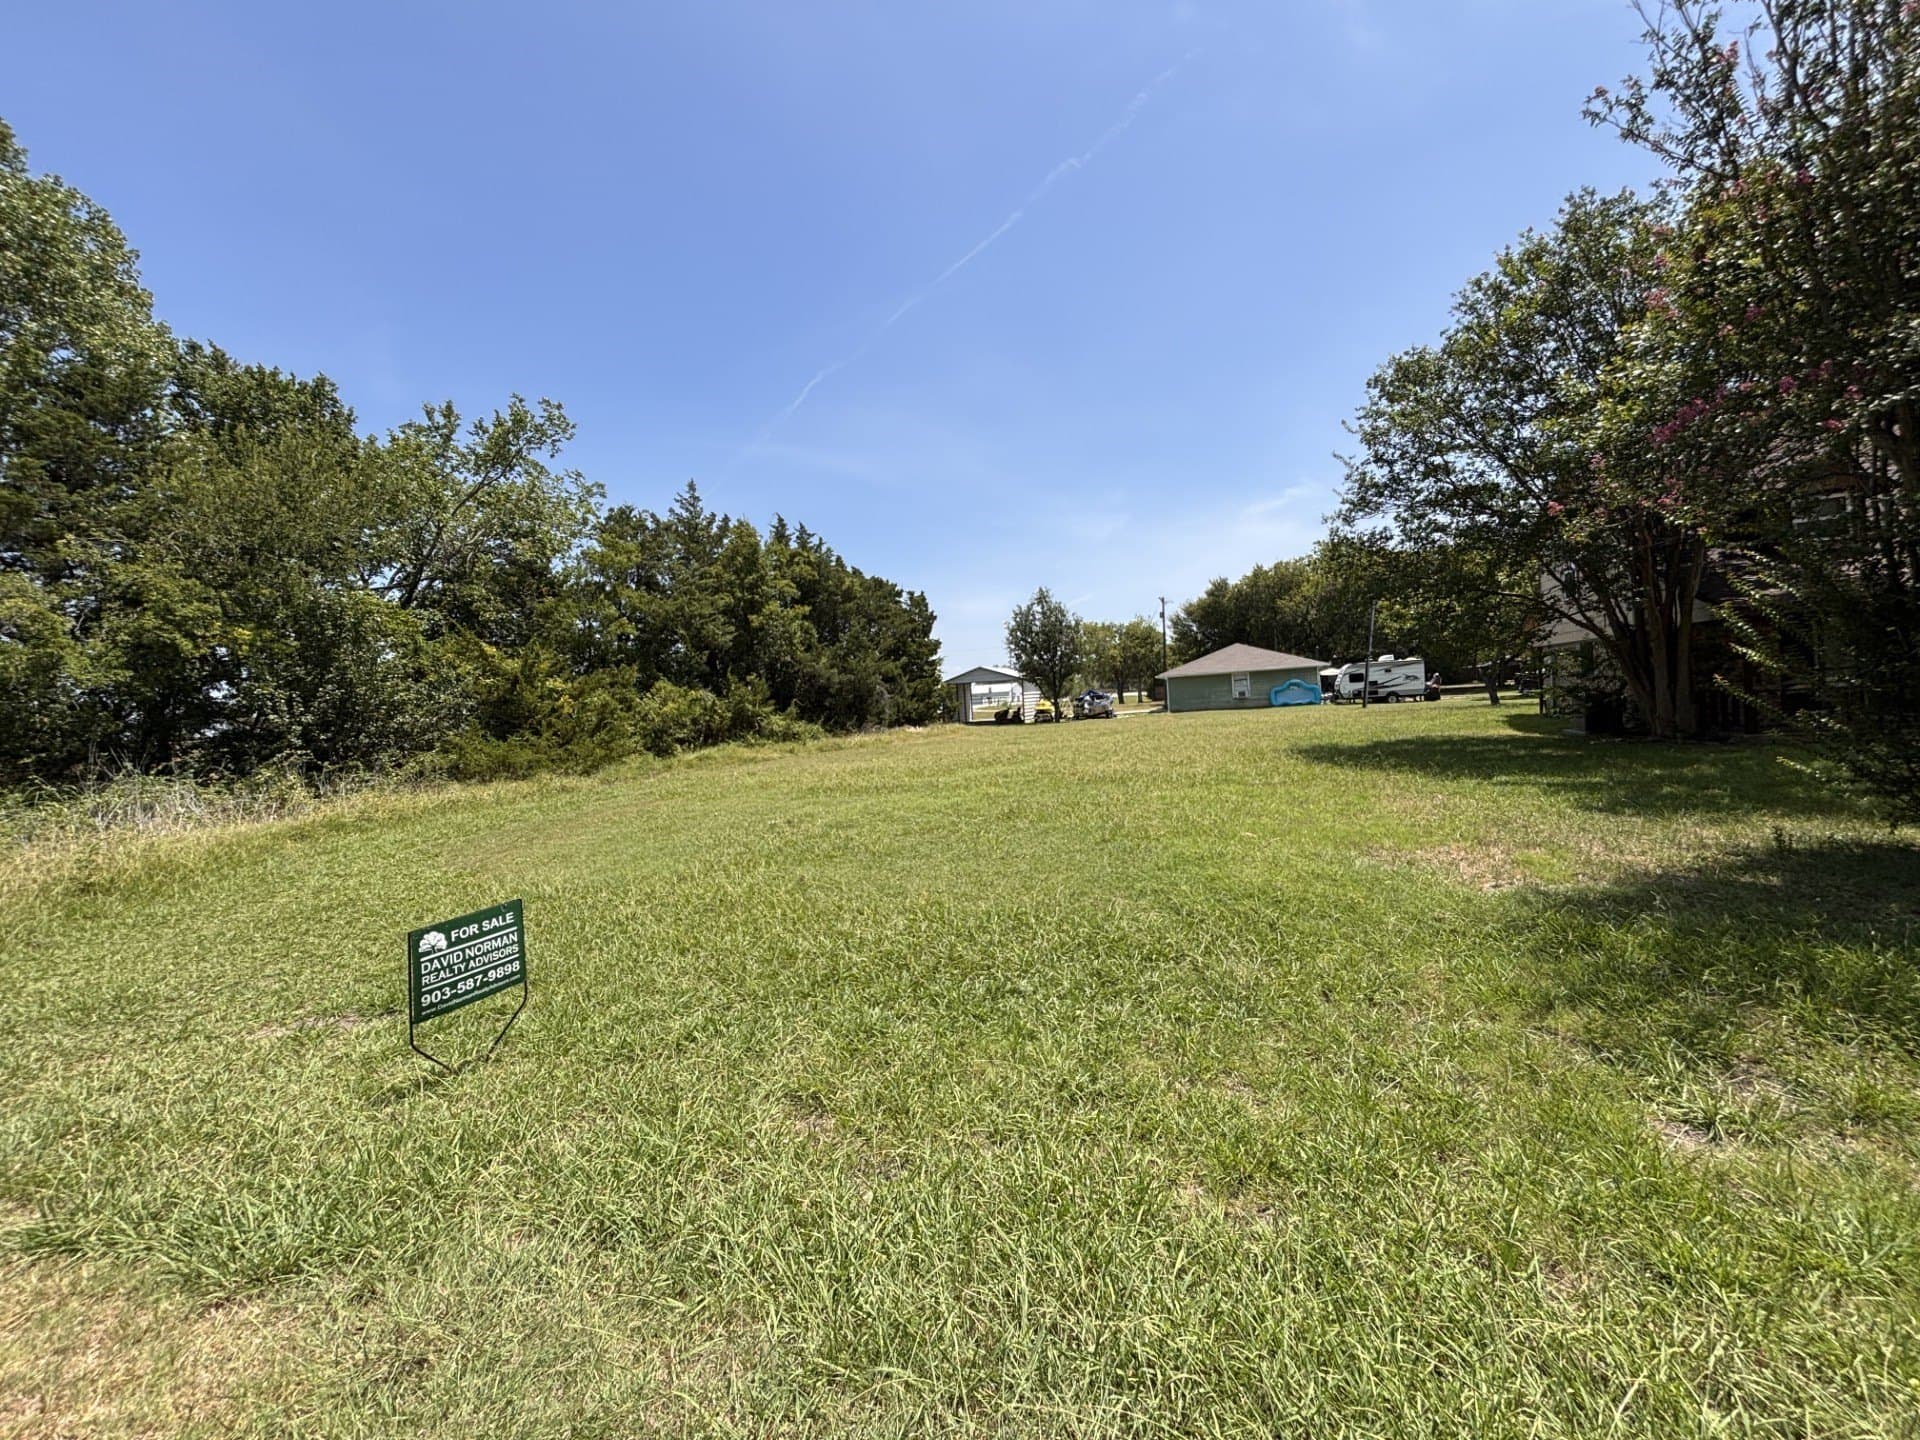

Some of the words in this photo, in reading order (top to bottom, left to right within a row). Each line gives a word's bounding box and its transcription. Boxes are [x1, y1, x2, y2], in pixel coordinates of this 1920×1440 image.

[451, 923, 479, 942] FOR
[482, 912, 514, 931] SALE
[421, 951, 463, 975] DAVID
[465, 932, 518, 959] NORMAN
[422, 962, 466, 986] REALTY
[468, 944, 519, 969] ADVISORS
[421, 960, 521, 1007] 903-587-9898
